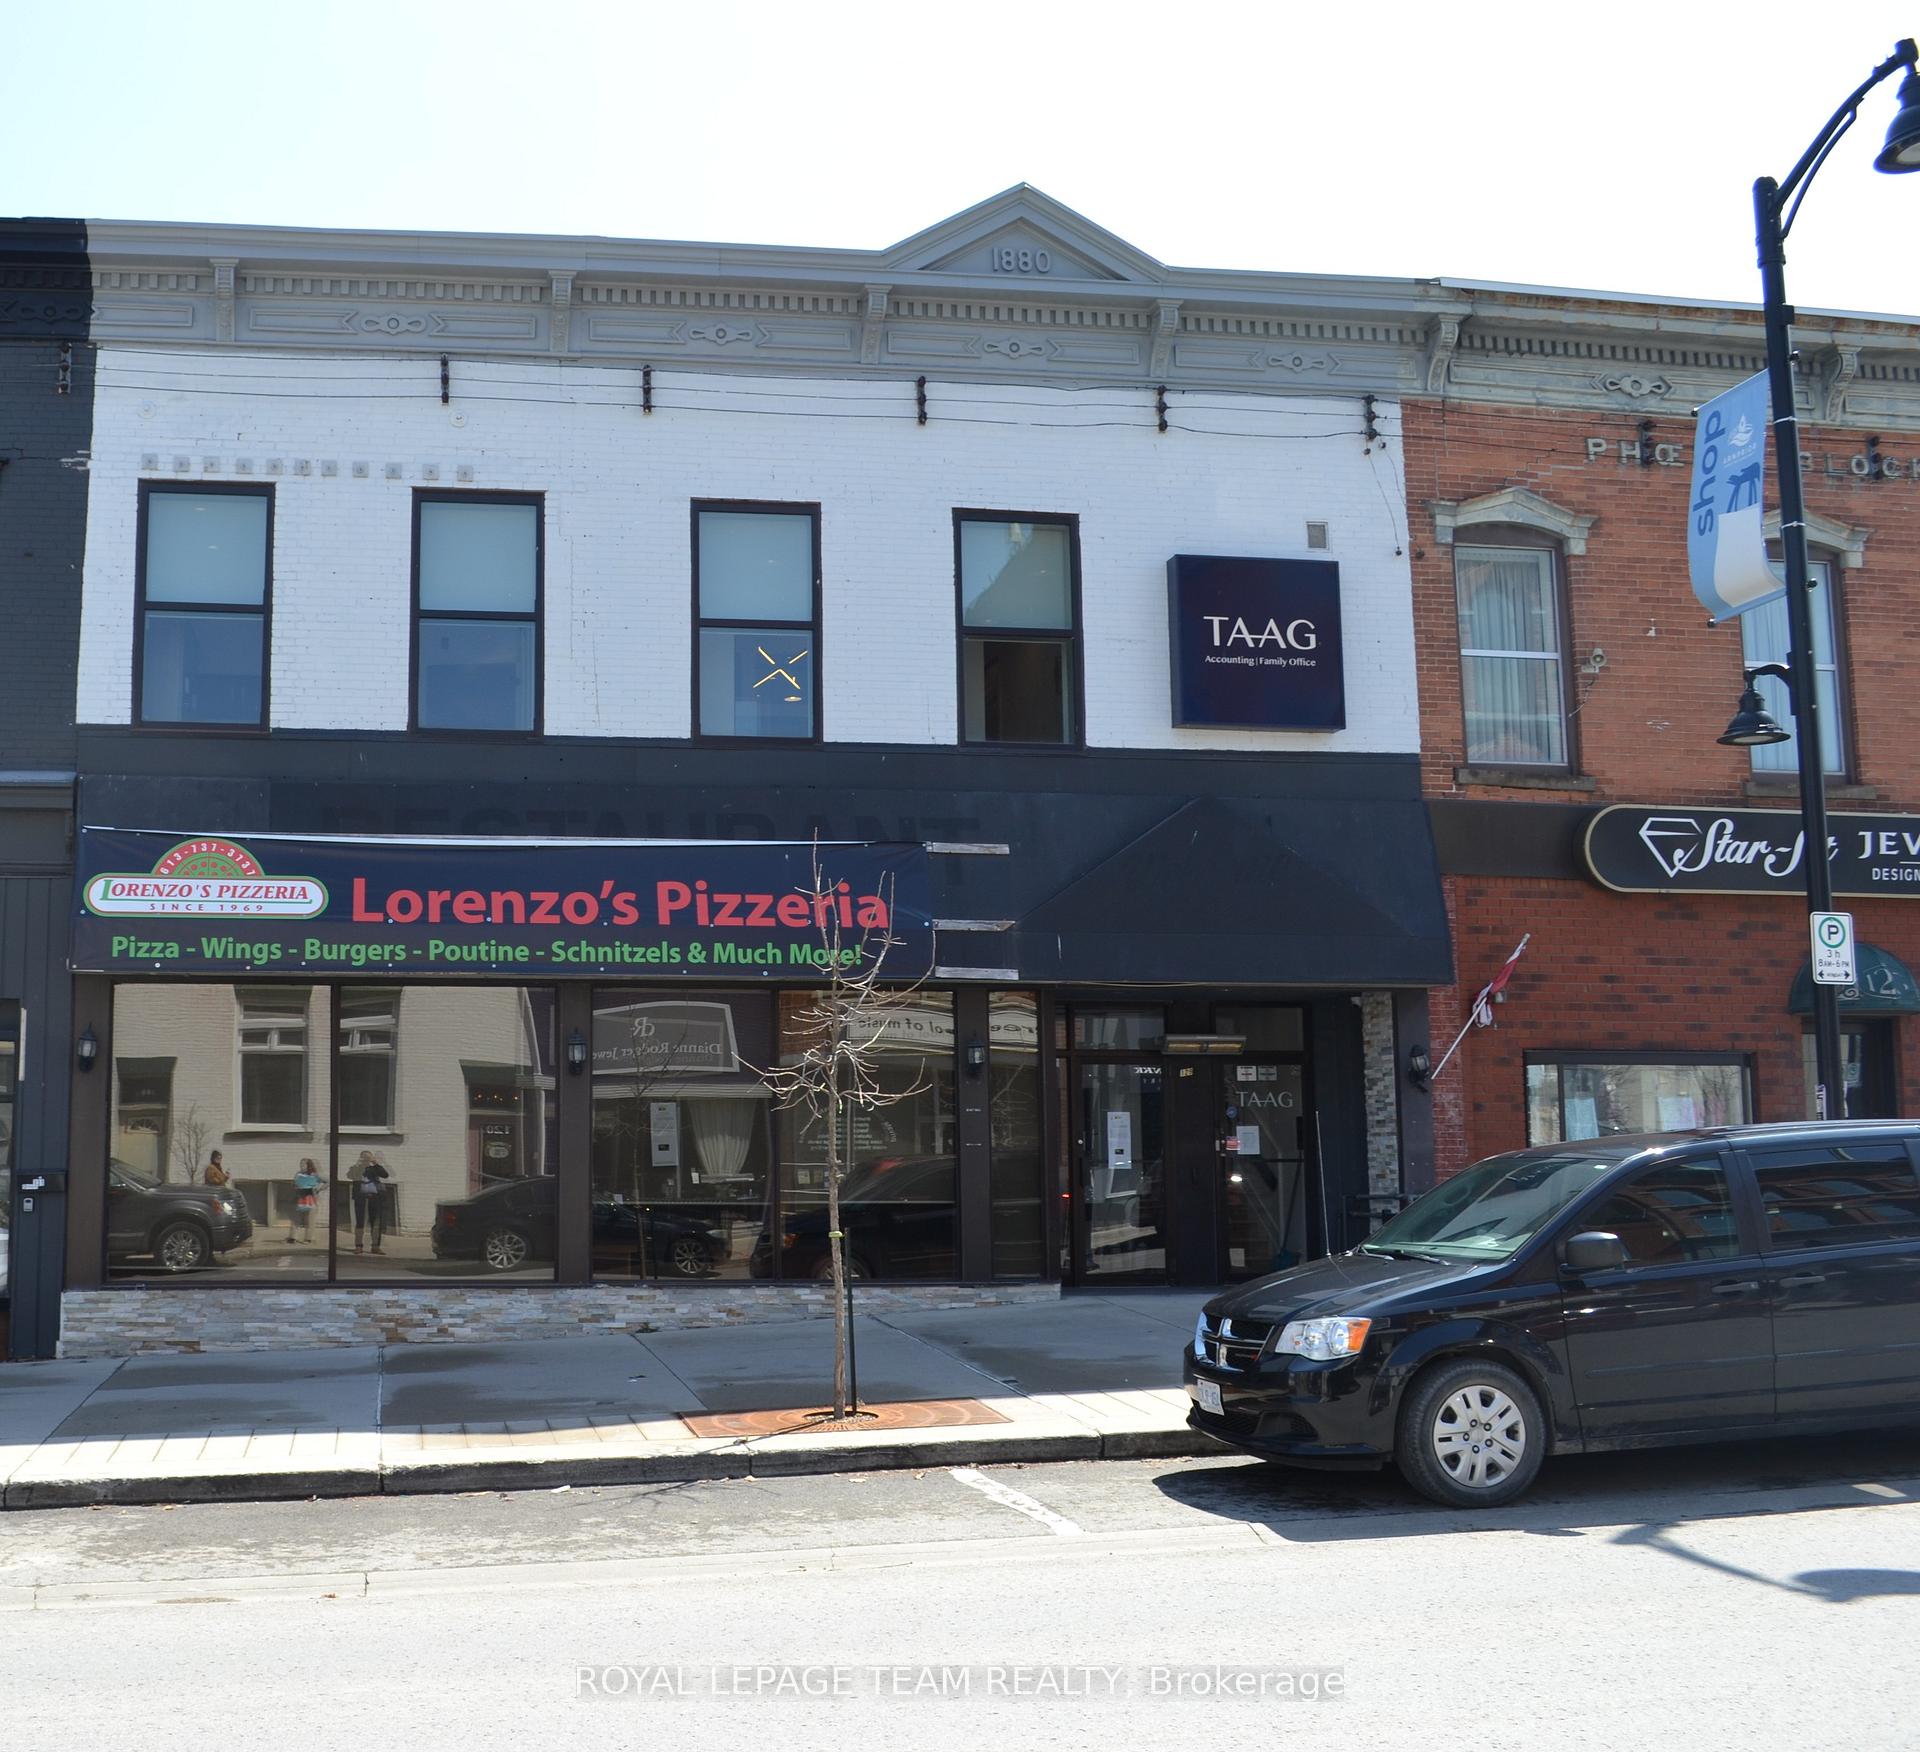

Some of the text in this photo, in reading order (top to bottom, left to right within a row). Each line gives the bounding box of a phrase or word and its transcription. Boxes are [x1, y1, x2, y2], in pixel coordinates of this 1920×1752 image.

[992, 247, 1050, 273] 1880
[1692, 410, 1727, 537] shop
[1203, 615, 1317, 650] TAAG
[1259, 657, 1287, 668] Family
[1288, 657, 1317, 667] Office
[159, 843, 256, 876] 613-737-3737
[99, 880, 309, 901] LORENZO'S PIZZERIA
[149, 903, 264, 912] SINCE 1969
[352, 877, 889, 929] Lorenzo’s Pizzeria
[1827, 925, 1839, 941] P
[111, 935, 181, 960] Pizza
[200, 935, 282, 966] Wings
[303, 937, 407, 967] Burgers
[427, 938, 530, 962] Poutine
[550, 939, 682, 965] Schnitzels
[687, 941, 708, 965] &
[713, 941, 785, 965] Much
[788, 943, 864, 966] More!
[1827, 949, 1833, 958] 3
[1235, 1090, 1294, 1109] TAAG
